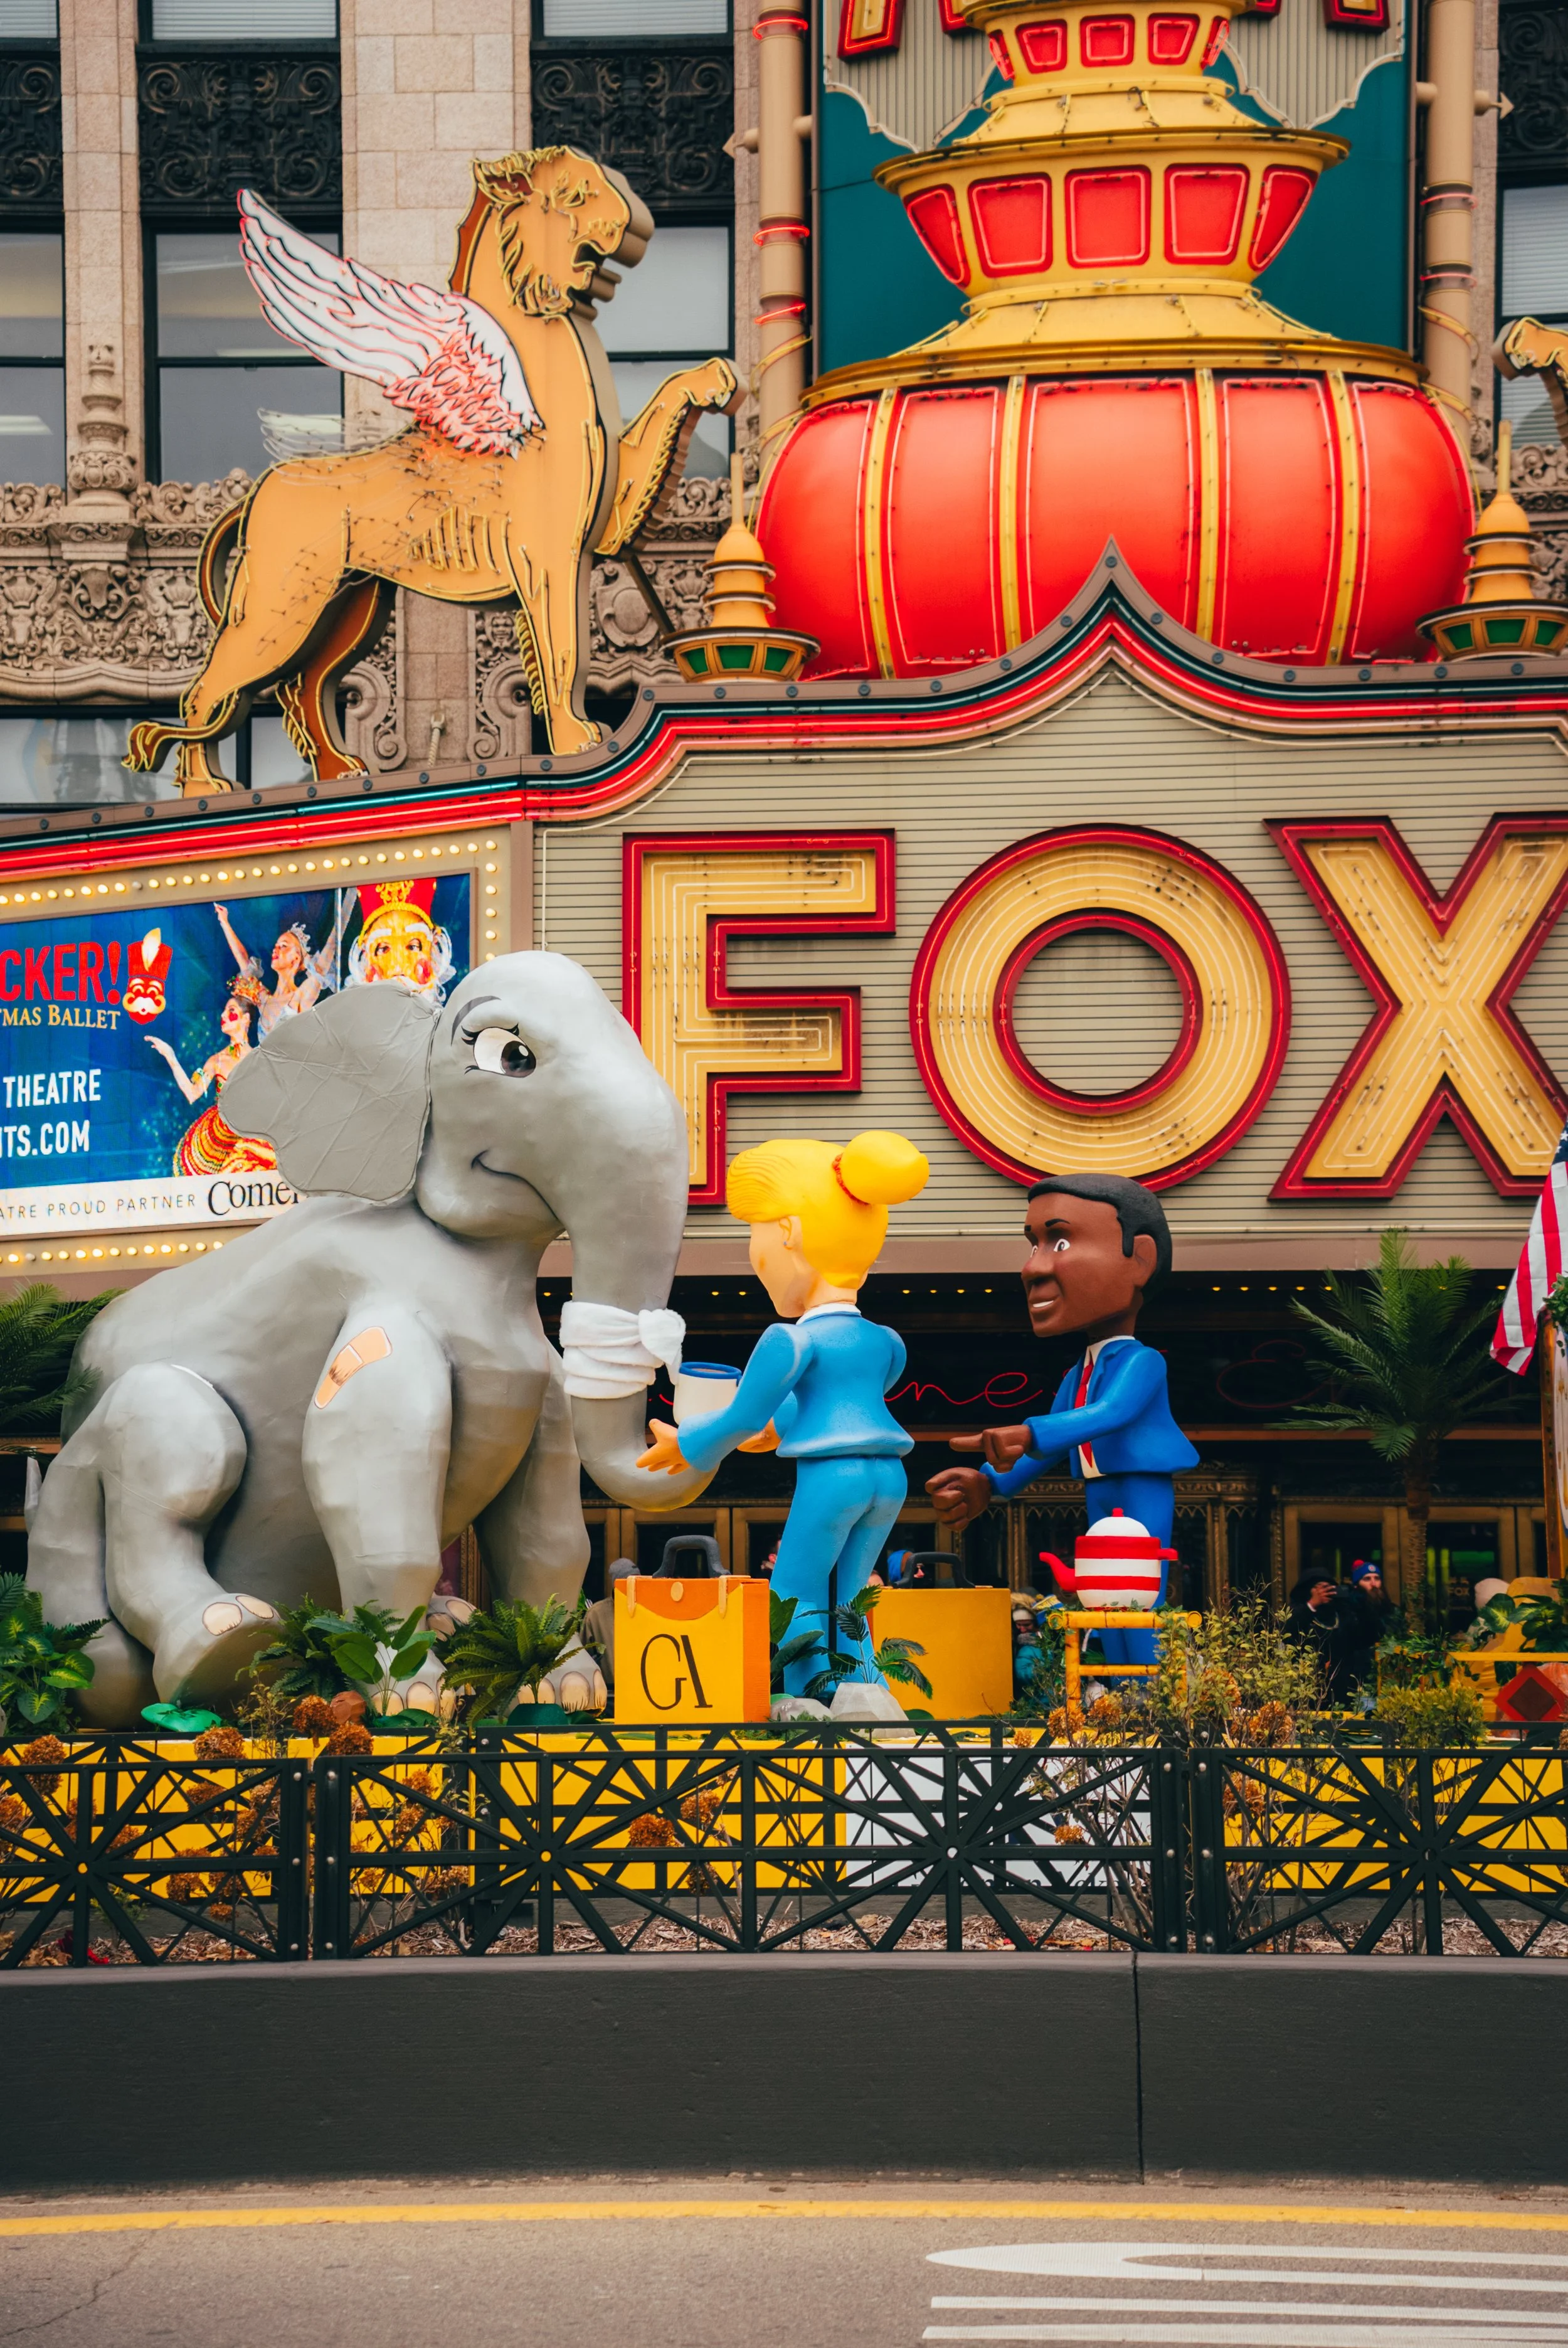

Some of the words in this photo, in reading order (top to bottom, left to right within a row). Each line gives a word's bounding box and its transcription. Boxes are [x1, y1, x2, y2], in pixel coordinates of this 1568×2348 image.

[0, 941, 121, 1005] CKER!
[0, 1007, 42, 1027] MAS
[622, 812, 1568, 1205] FOX
[3, 1068, 101, 1108] THEATRE
[0, 1119, 90, 1159] TS.COM
[48, 1199, 105, 1216] PROUD
[117, 1194, 196, 1211] PARTNER
